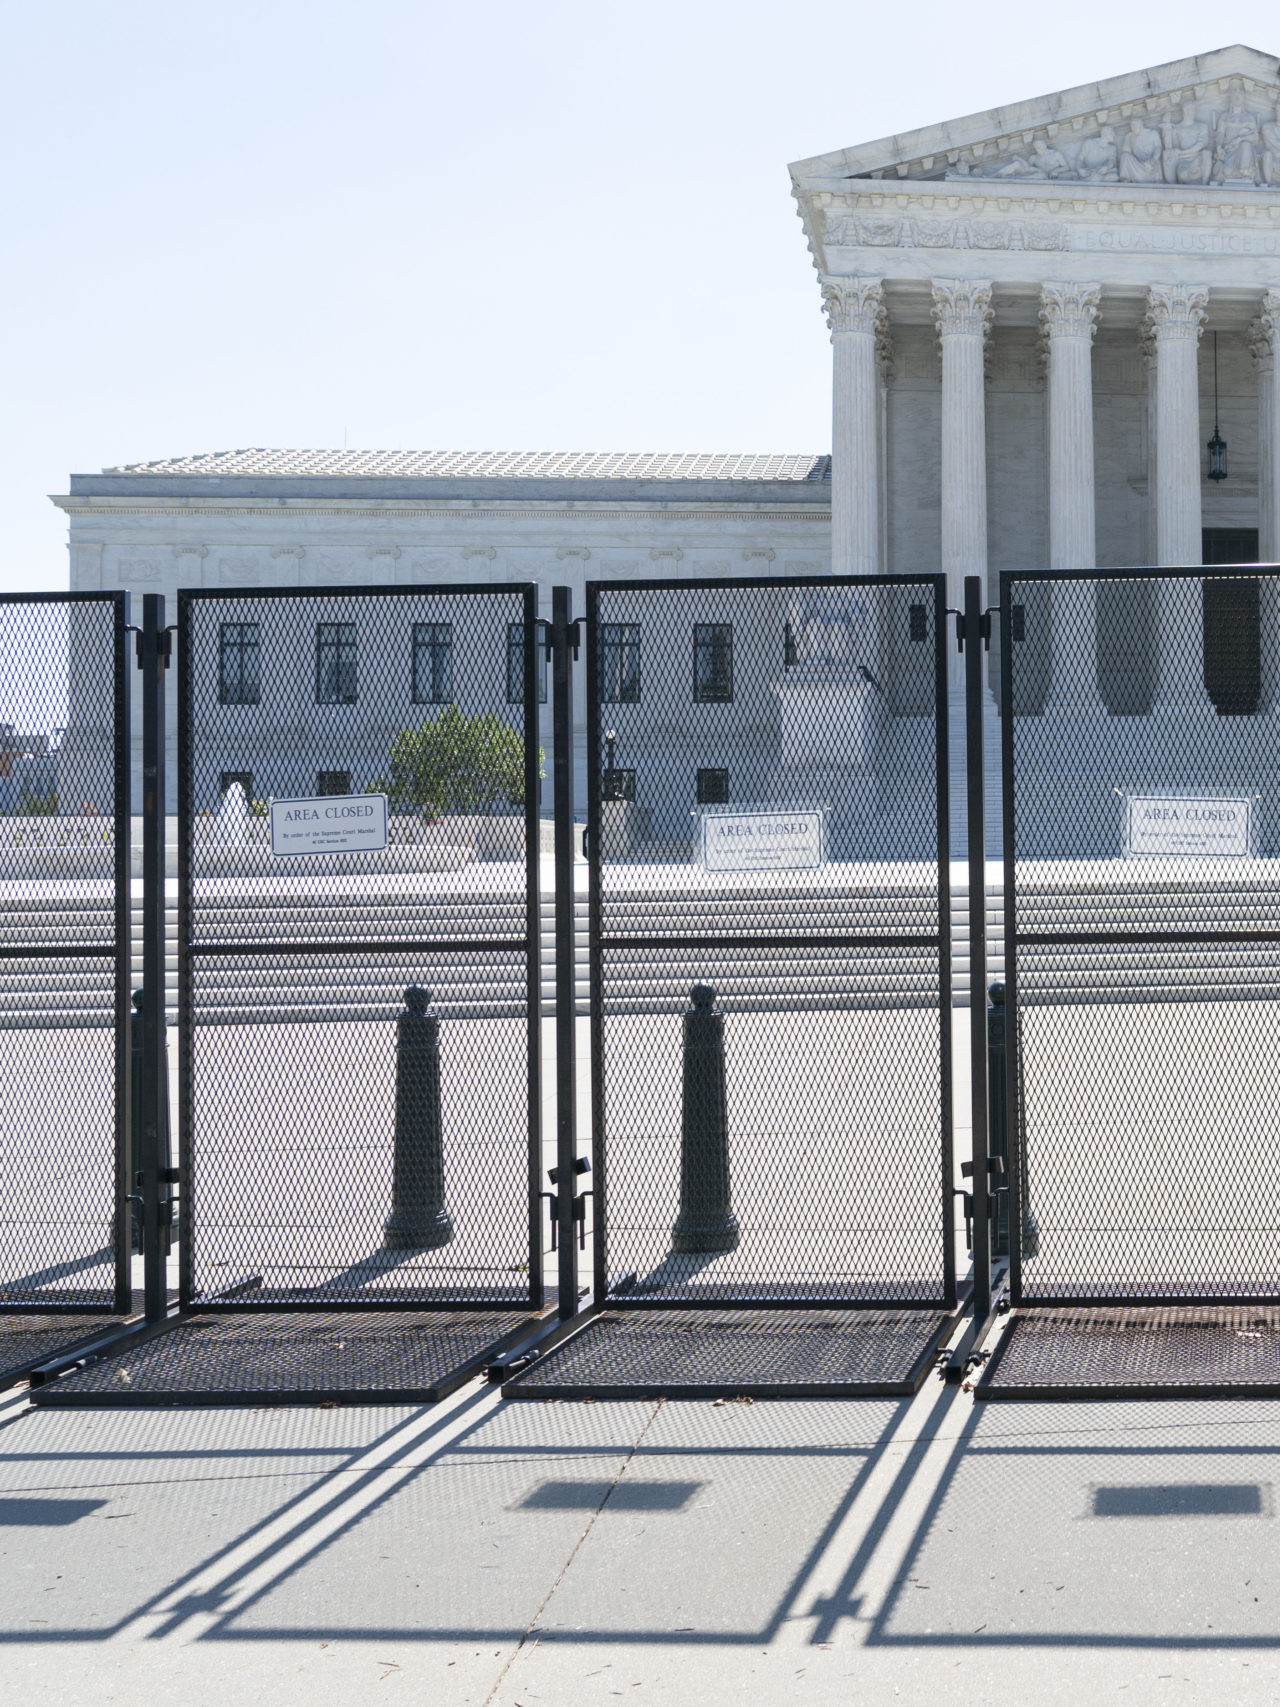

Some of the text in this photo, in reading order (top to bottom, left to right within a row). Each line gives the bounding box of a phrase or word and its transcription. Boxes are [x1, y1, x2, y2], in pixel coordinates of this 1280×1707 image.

[1086, 231, 1160, 249] EQUAL
[1170, 232, 1251, 251] JUSTICE
[285, 805, 374, 821] AREA CLOSED
[1143, 808, 1236, 821] AREA CLOSED
[717, 823, 808, 837] AREA CLOSED
